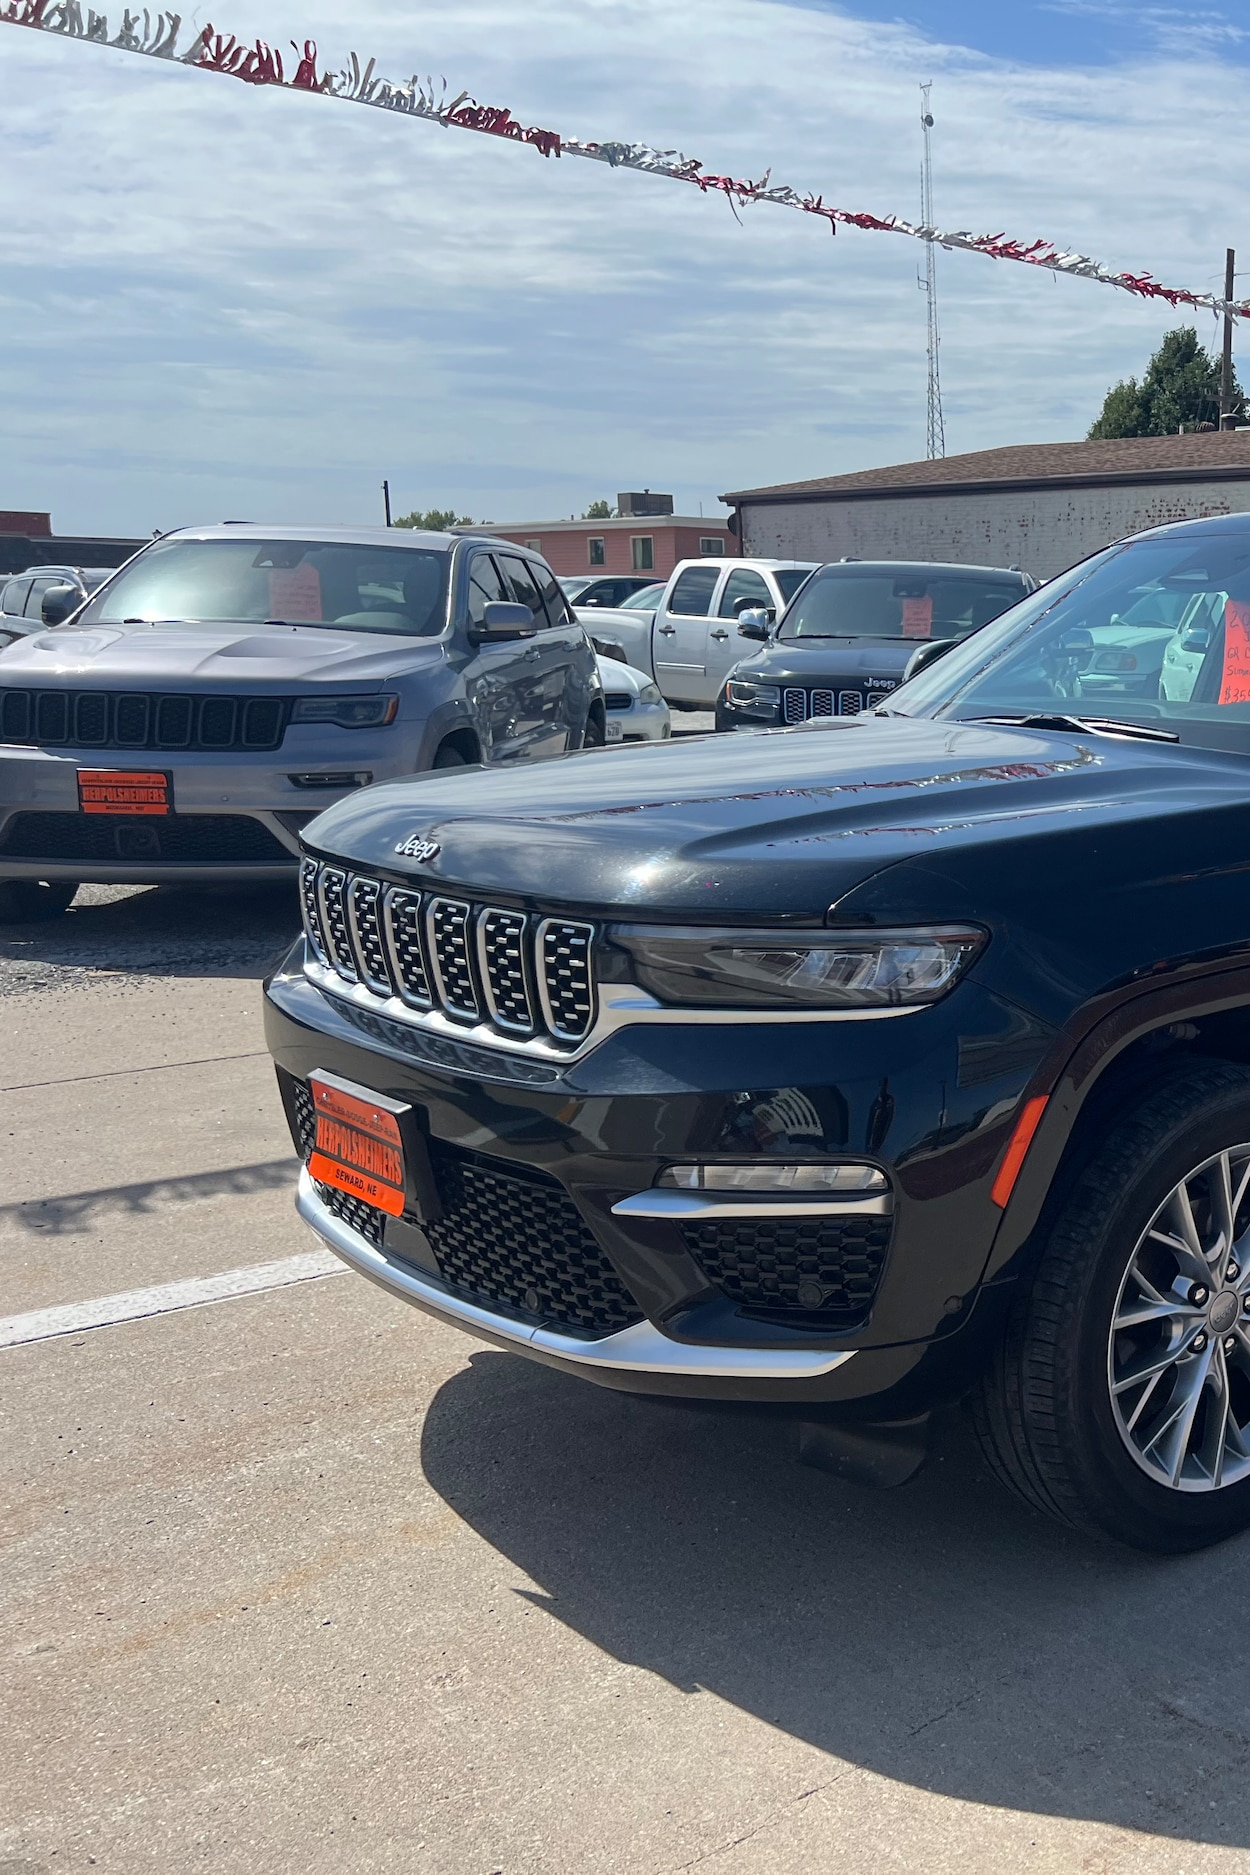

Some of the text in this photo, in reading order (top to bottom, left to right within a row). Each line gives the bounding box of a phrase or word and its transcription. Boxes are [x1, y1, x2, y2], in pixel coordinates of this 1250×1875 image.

[863, 676, 896, 690] Jeep
[394, 833, 440, 863] Jeep
[315, 1115, 403, 1186] HERPOLSHEIMERS
[335, 1168, 377, 1196] SEWARD, NE
